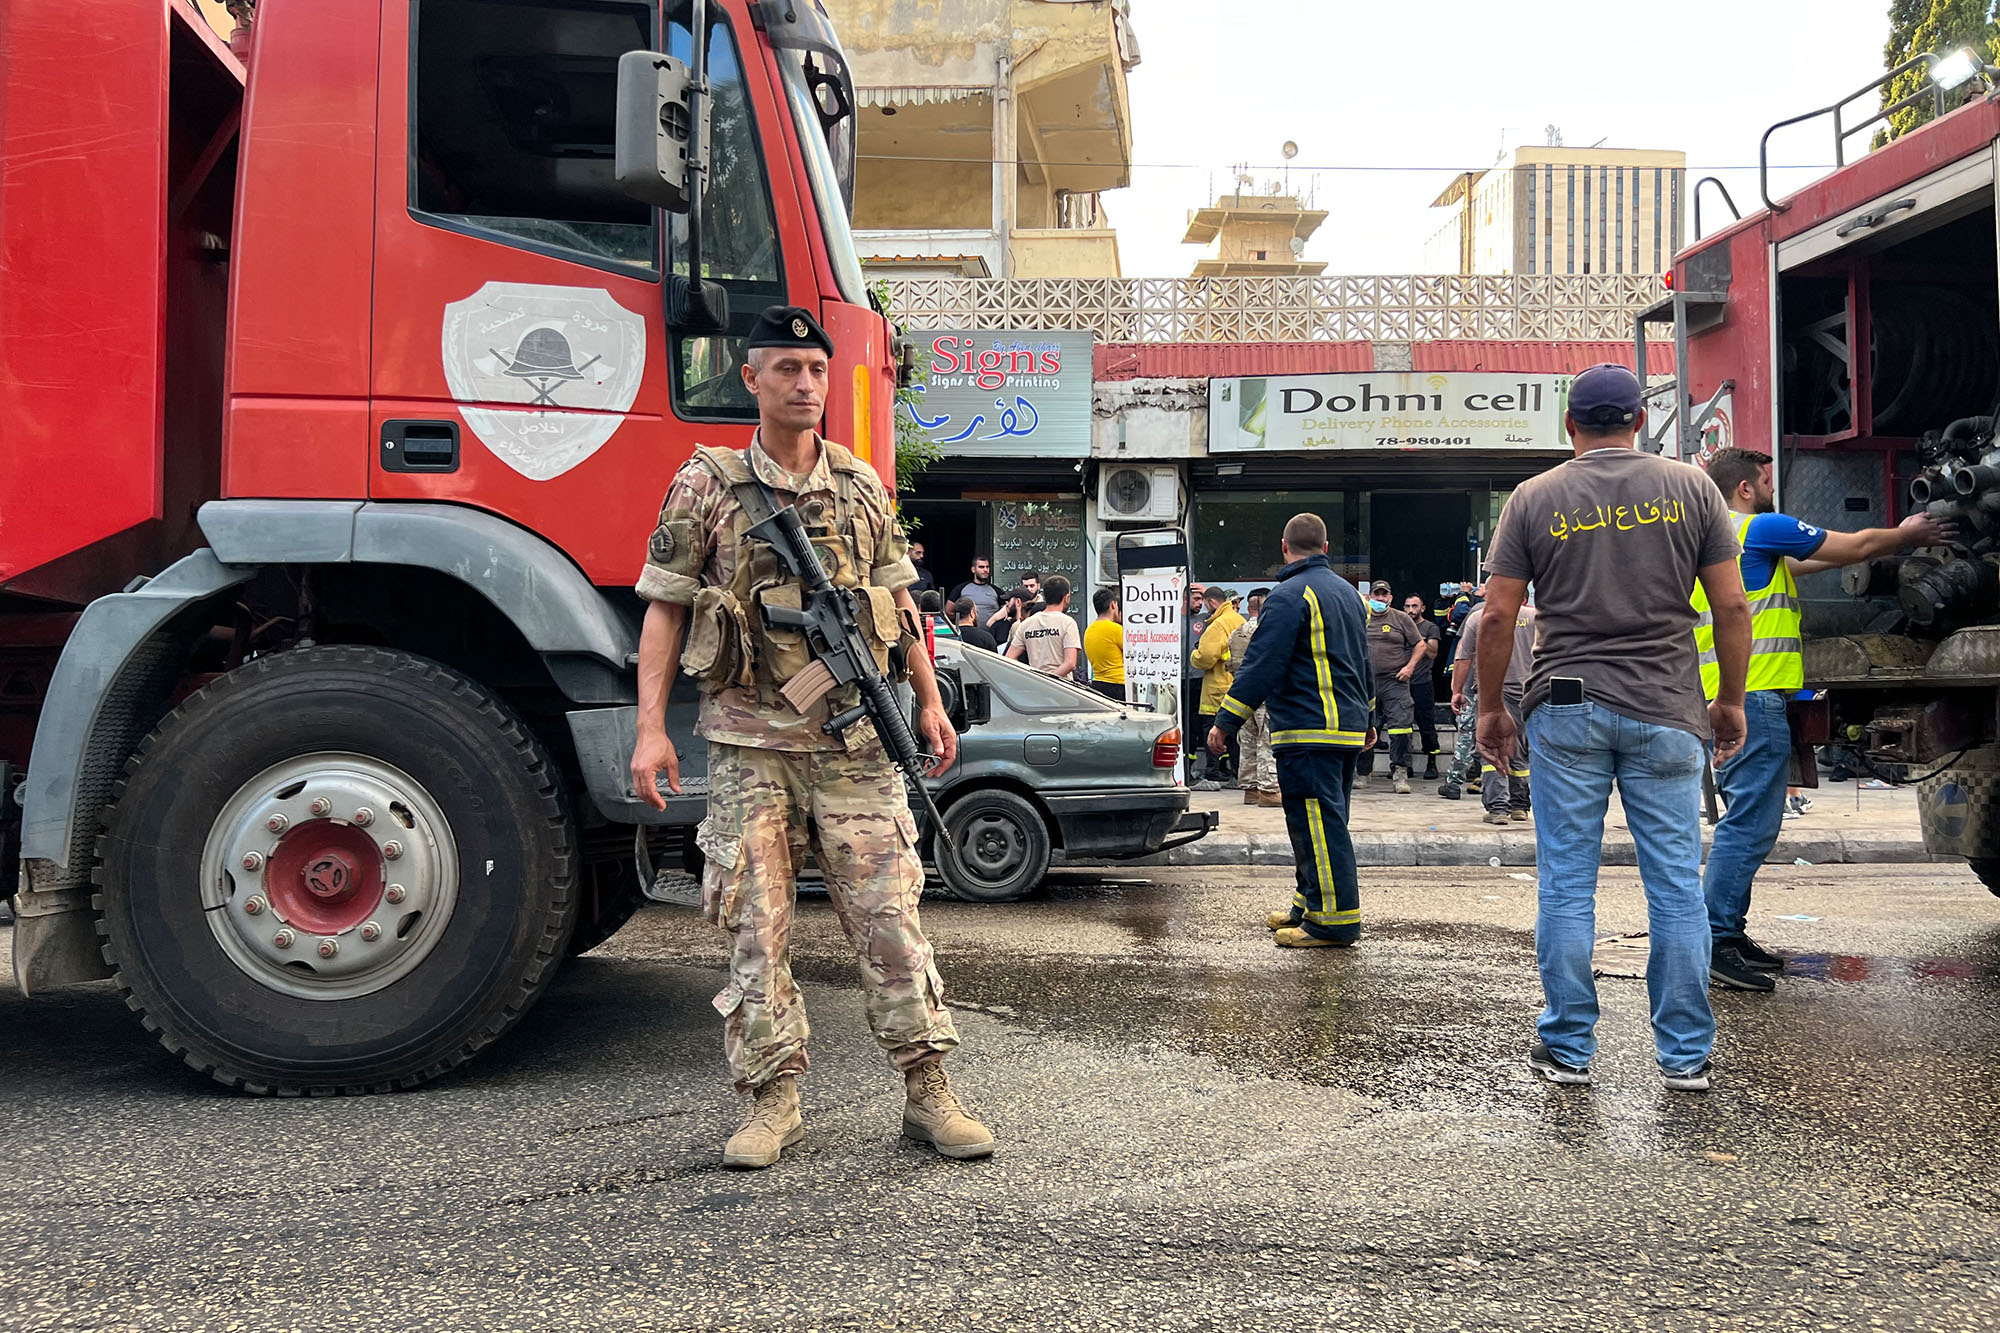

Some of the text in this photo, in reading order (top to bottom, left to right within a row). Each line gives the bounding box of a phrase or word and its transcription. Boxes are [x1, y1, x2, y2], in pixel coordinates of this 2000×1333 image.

[931, 336, 1061, 389] Signs
[931, 375, 1060, 390] Signs & Printing
[1280, 383, 1541, 414] Dohni cell
[1302, 415, 1529, 433] Delivery Phone Accessories
[1302, 435, 1336, 446] مفرق
[1376, 437, 1471, 446] 78-980401
[1504, 434, 1533, 445] جملة
[1125, 583, 1179, 602] Dohni
[1128, 605, 1174, 624] cell
[1125, 629, 1180, 647] Original Accessories
[1138, 666, 1157, 680] صيانة
